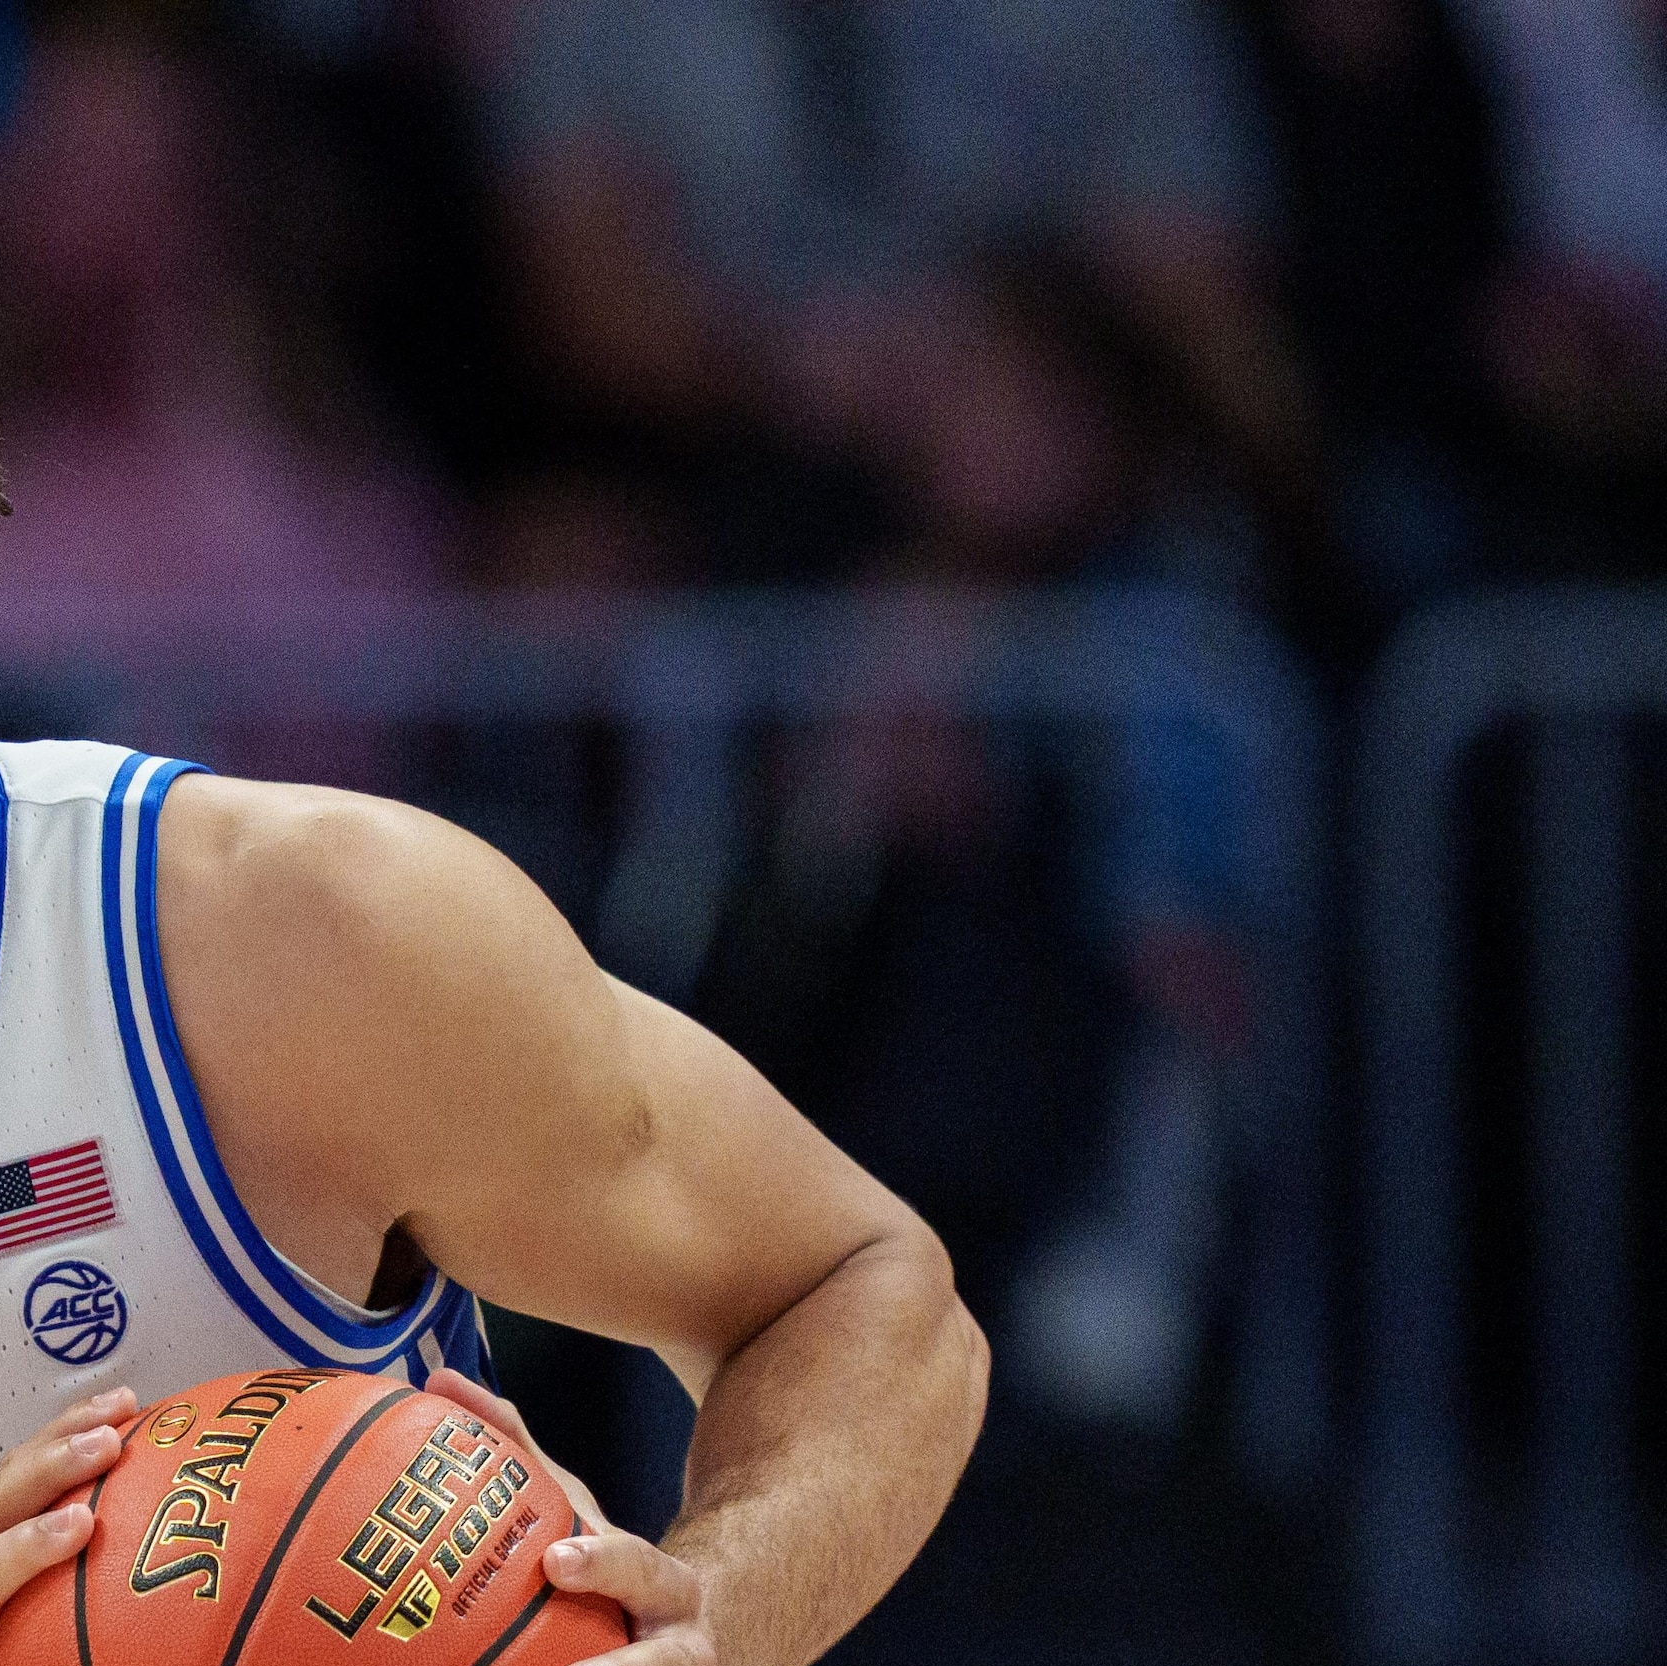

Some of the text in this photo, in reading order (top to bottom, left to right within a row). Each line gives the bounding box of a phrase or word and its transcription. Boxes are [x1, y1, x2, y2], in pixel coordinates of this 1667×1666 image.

[39, 1286, 116, 1324] ACC
[129, 1368, 346, 1602] SPALDIN
[429, 1456, 531, 1582] 1000
[451, 1505, 540, 1619] OFFICIAL GAME BALL
